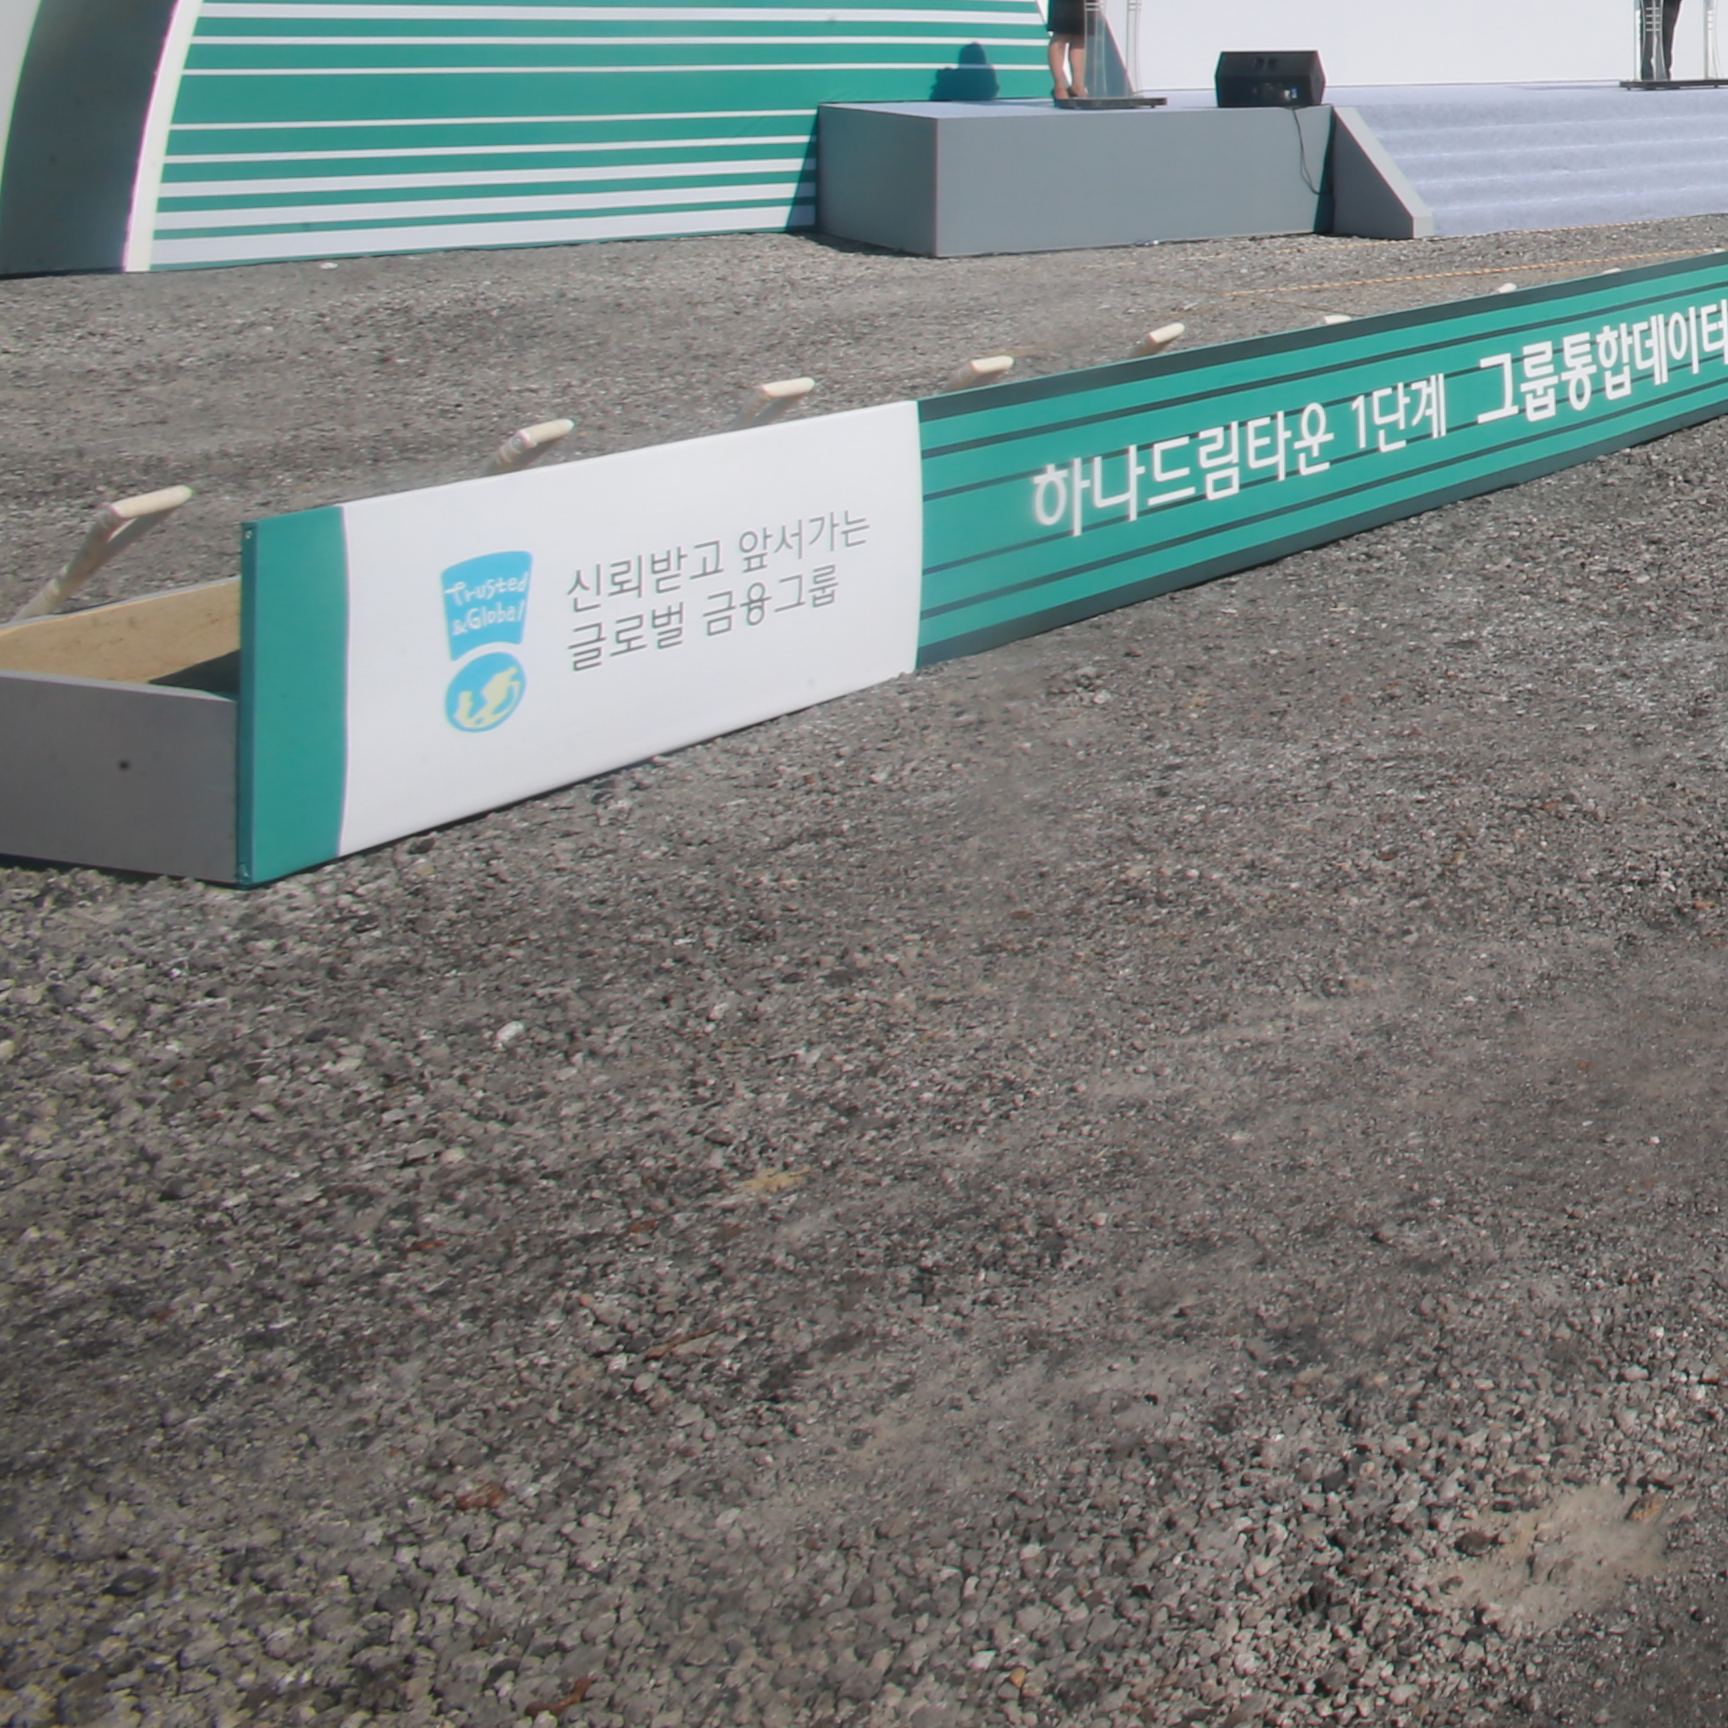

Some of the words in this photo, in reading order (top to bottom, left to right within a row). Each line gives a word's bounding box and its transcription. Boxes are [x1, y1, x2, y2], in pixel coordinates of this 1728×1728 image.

[1033, 402, 1334, 537] 하나드림타운
[1351, 373, 1446, 452] 1단계
[444, 570, 529, 606] Trusted
[566, 539, 724, 613] 신뢰받고
[738, 509, 870, 574] 앞서가는
[452, 600, 525, 636] &Global
[567, 601, 685, 672] 글로벌
[701, 564, 838, 637] 금융그룹
